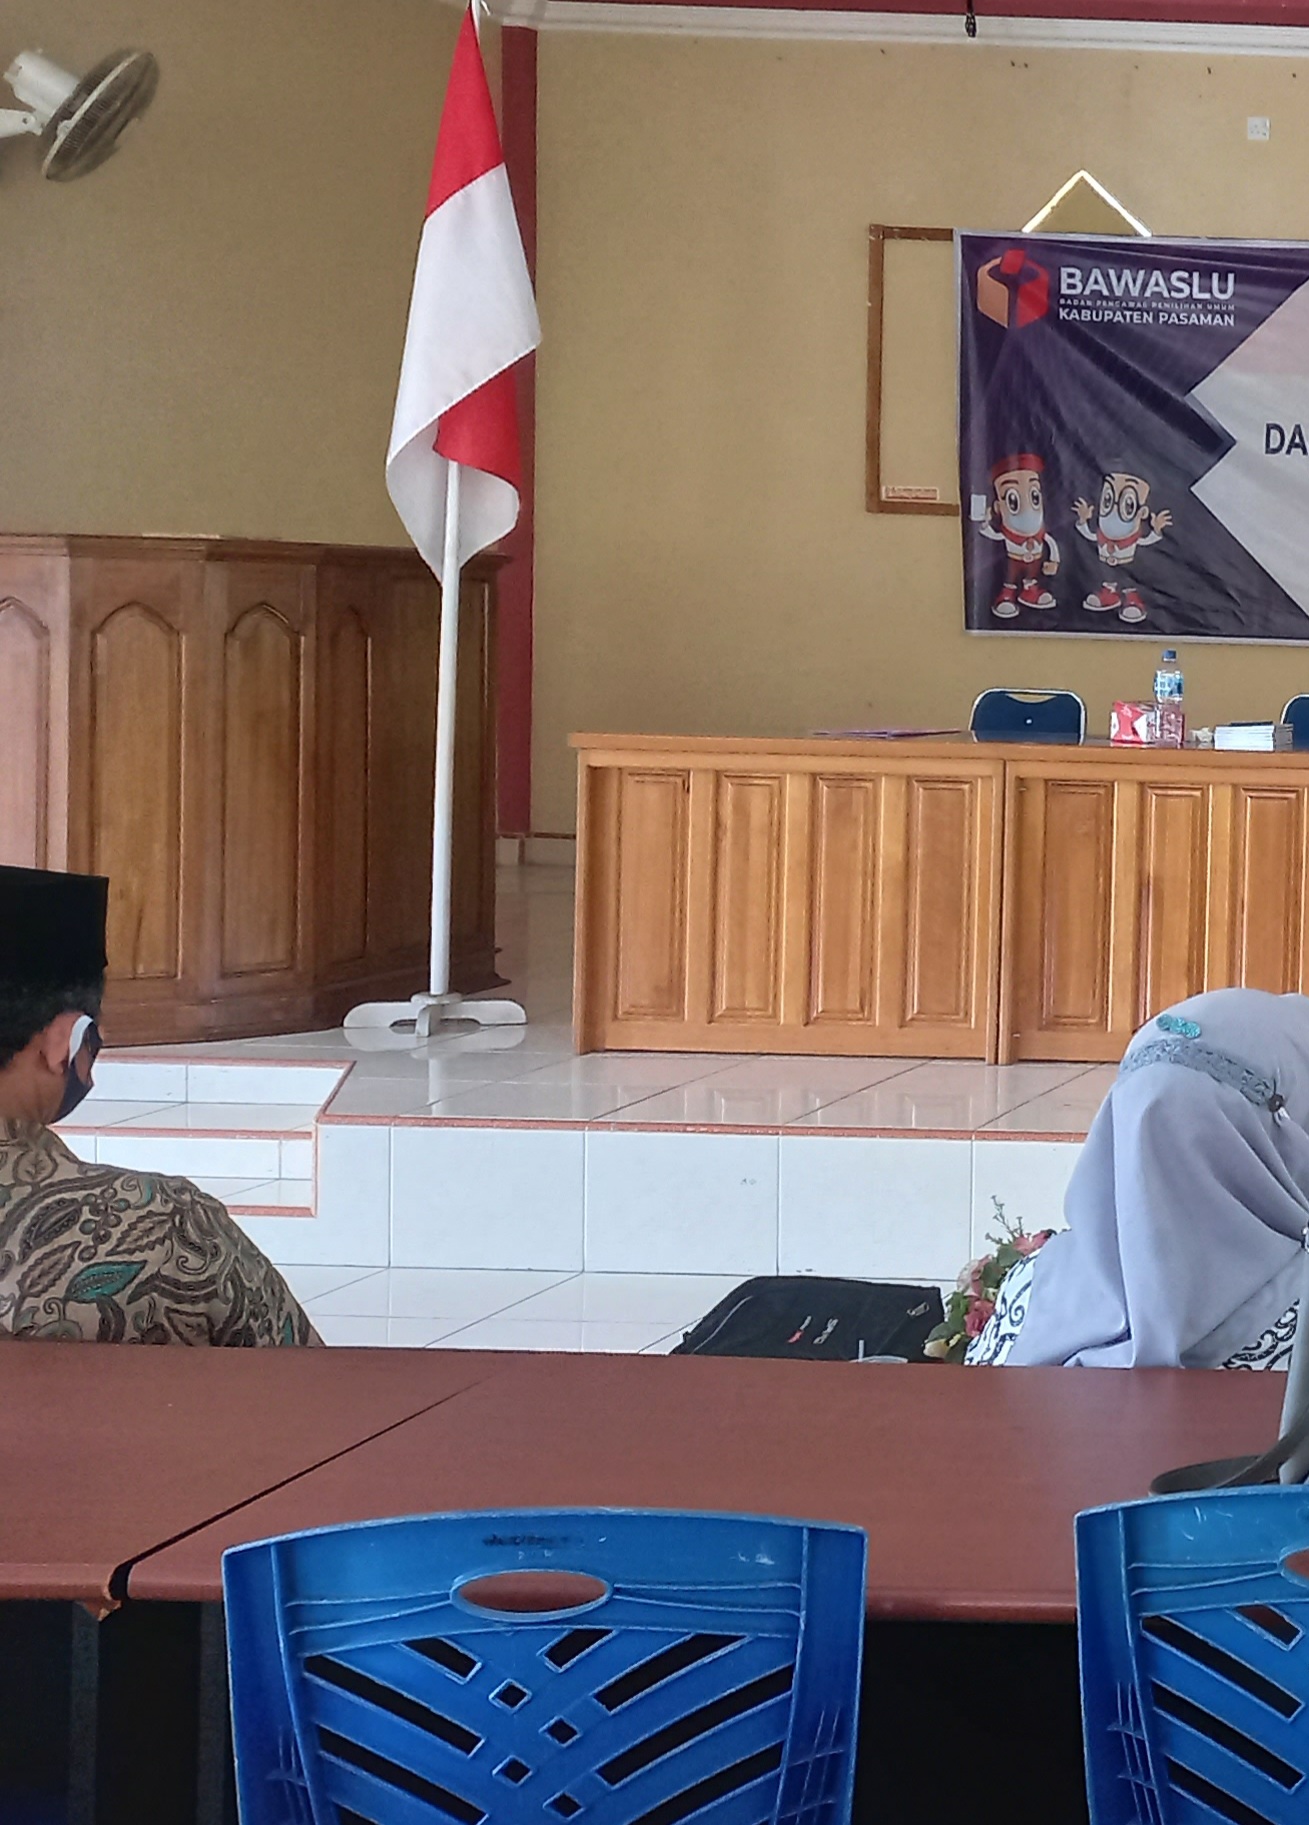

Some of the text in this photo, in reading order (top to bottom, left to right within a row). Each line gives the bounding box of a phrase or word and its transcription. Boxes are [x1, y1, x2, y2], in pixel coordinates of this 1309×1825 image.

[1060, 267, 1235, 300] BAWASLU
[1059, 308, 1235, 327] KABUPATEN PASAMAN
